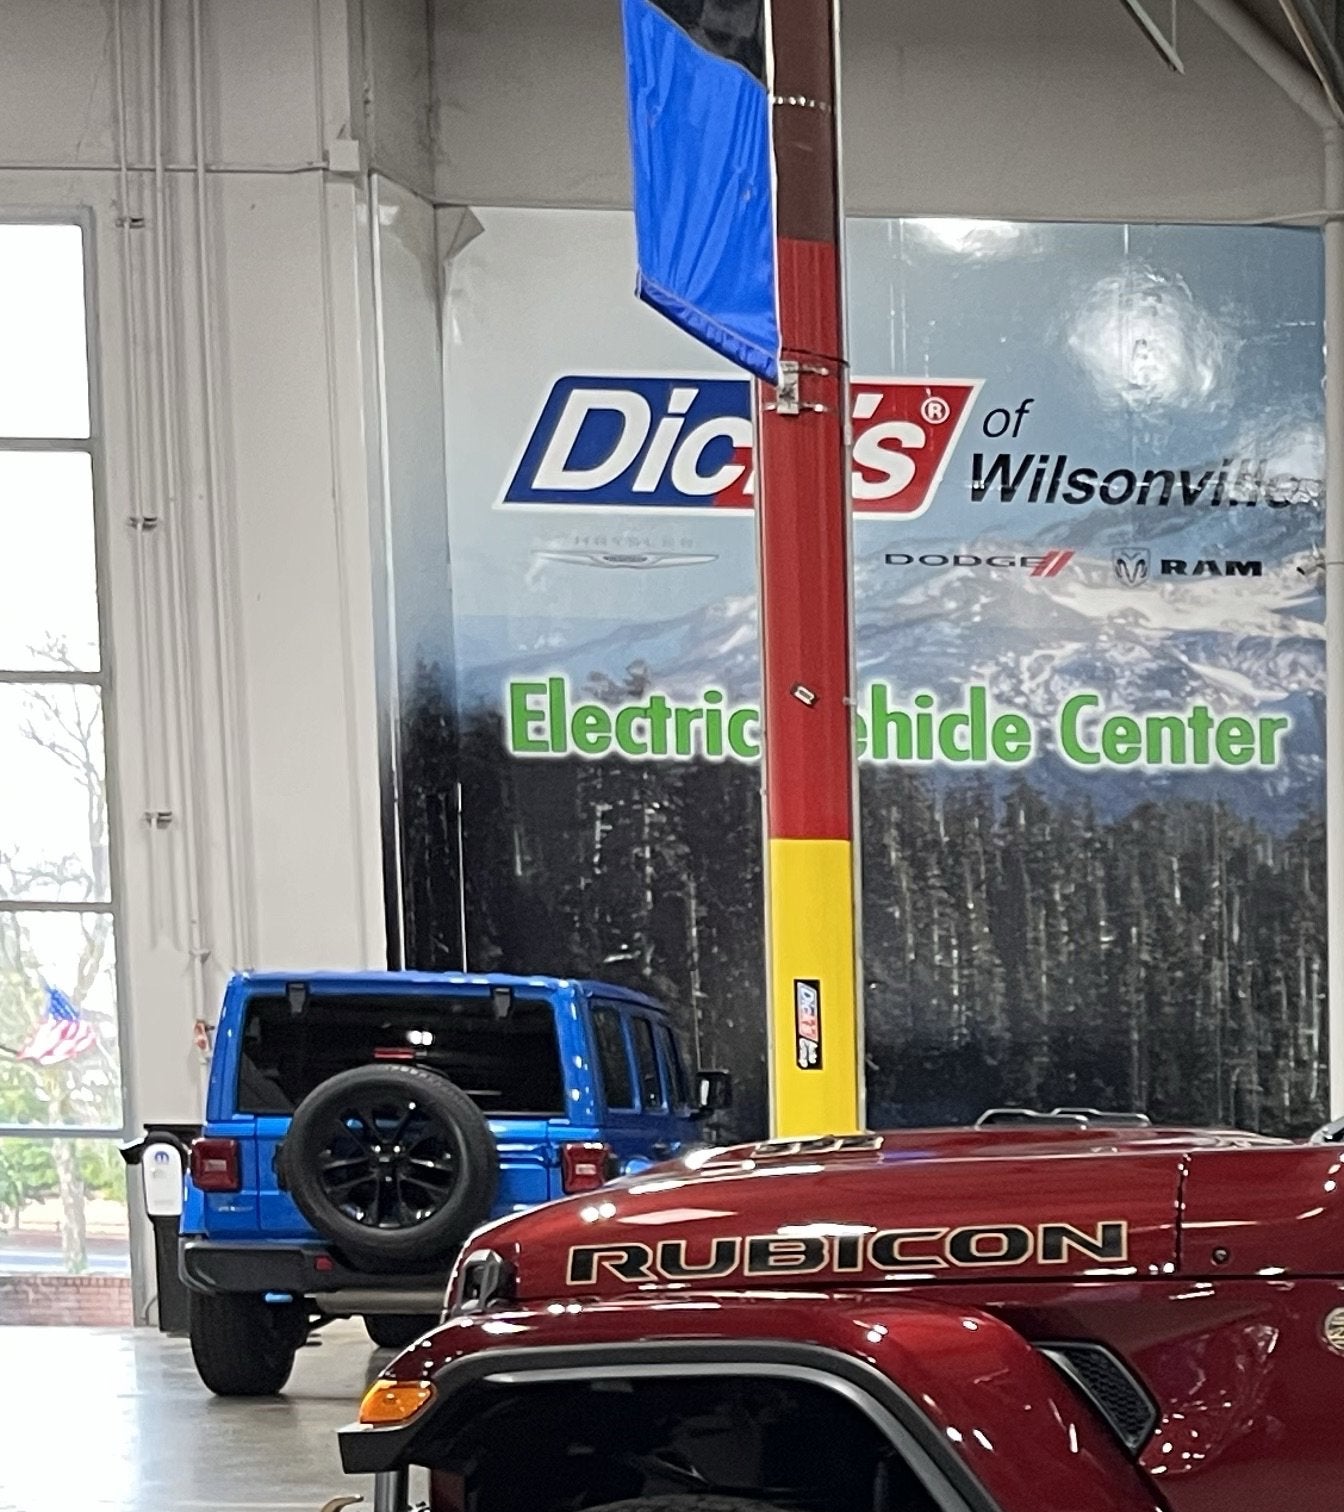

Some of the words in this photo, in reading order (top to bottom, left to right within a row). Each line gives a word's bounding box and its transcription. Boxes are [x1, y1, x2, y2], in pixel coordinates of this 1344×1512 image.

[982, 398, 1034, 438] of
[884, 553, 1048, 567] DODGE
[1160, 559, 1263, 577] RAM
[509, 676, 760, 756] Electric
[1060, 694, 1288, 764] Center
[565, 1220, 1128, 1285] RUBICON
